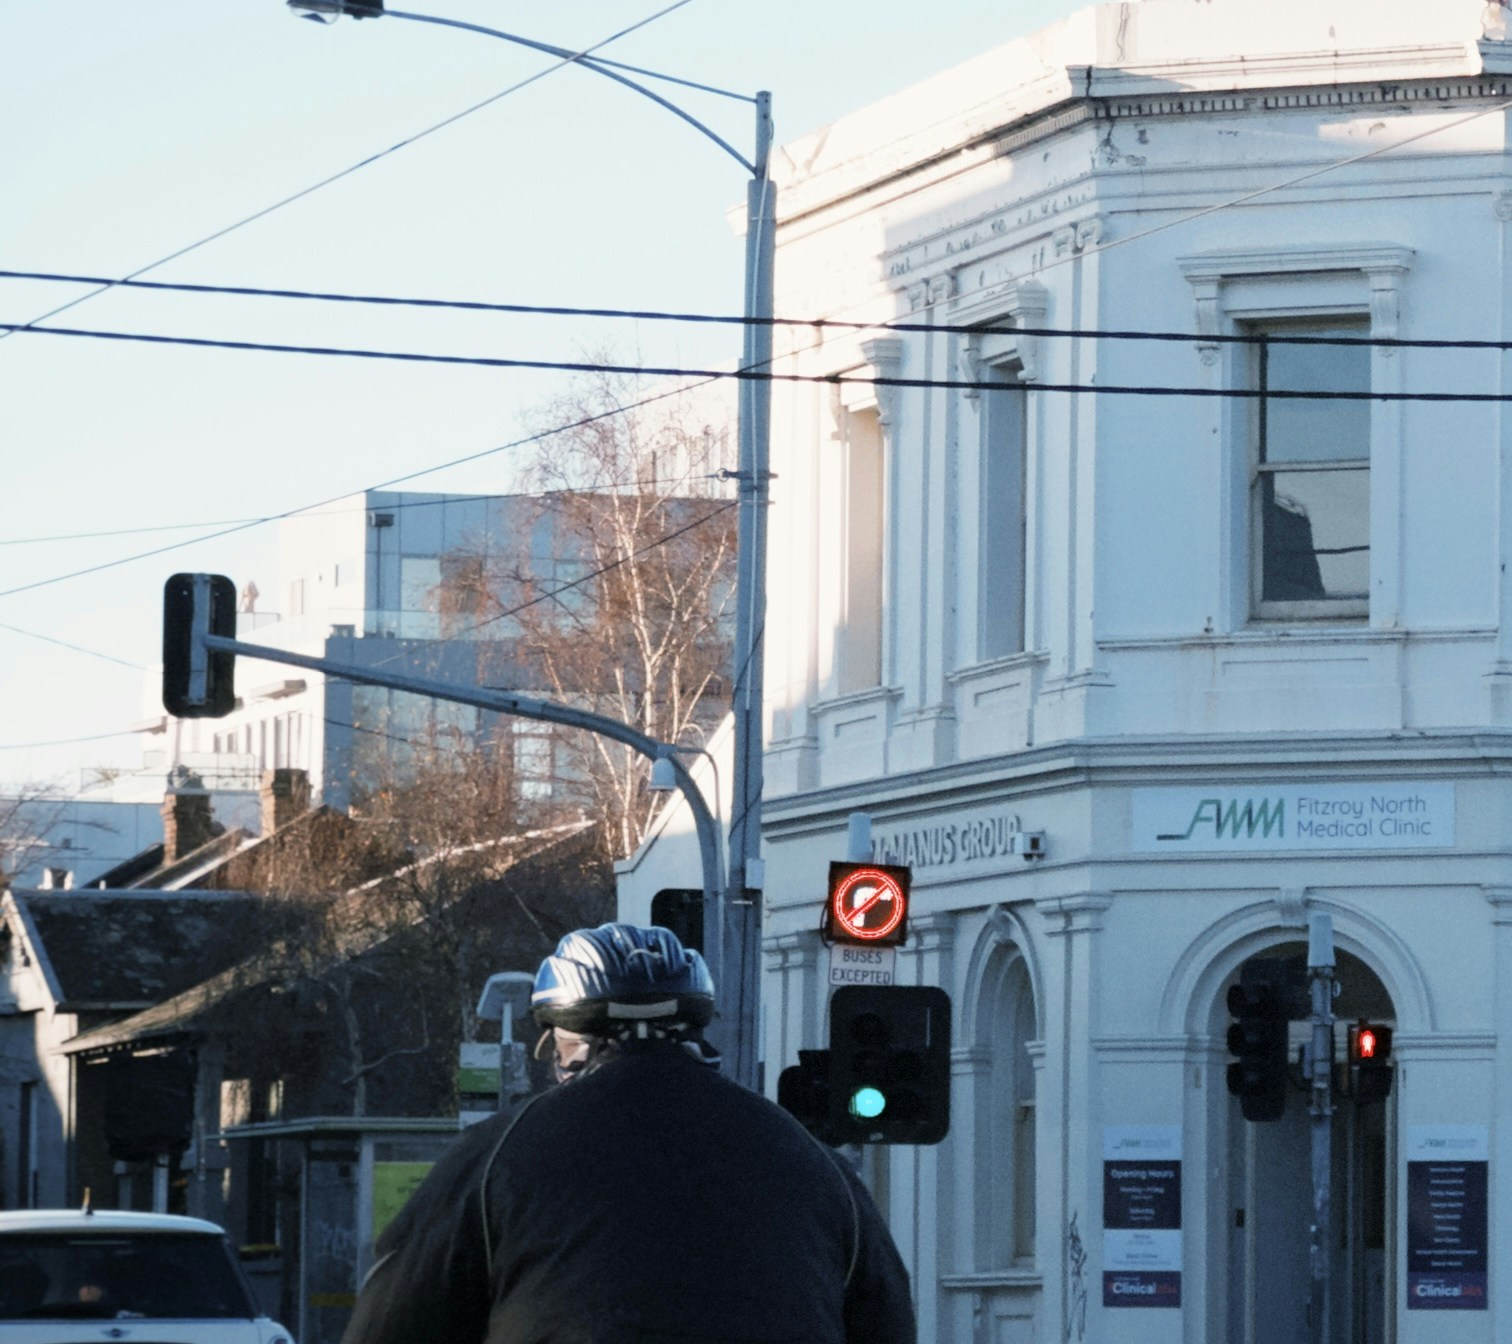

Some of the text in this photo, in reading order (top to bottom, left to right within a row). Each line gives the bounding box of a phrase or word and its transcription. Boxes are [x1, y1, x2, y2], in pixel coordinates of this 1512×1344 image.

[1297, 794, 1427, 819] Fitzroy North
[960, 815, 1021, 860] GROUP
[1297, 816, 1432, 839] Medical Clinic
[843, 949, 883, 965] BUSES
[831, 967, 891, 985] EXCEPTED
[1111, 1168, 1147, 1181] Opening
